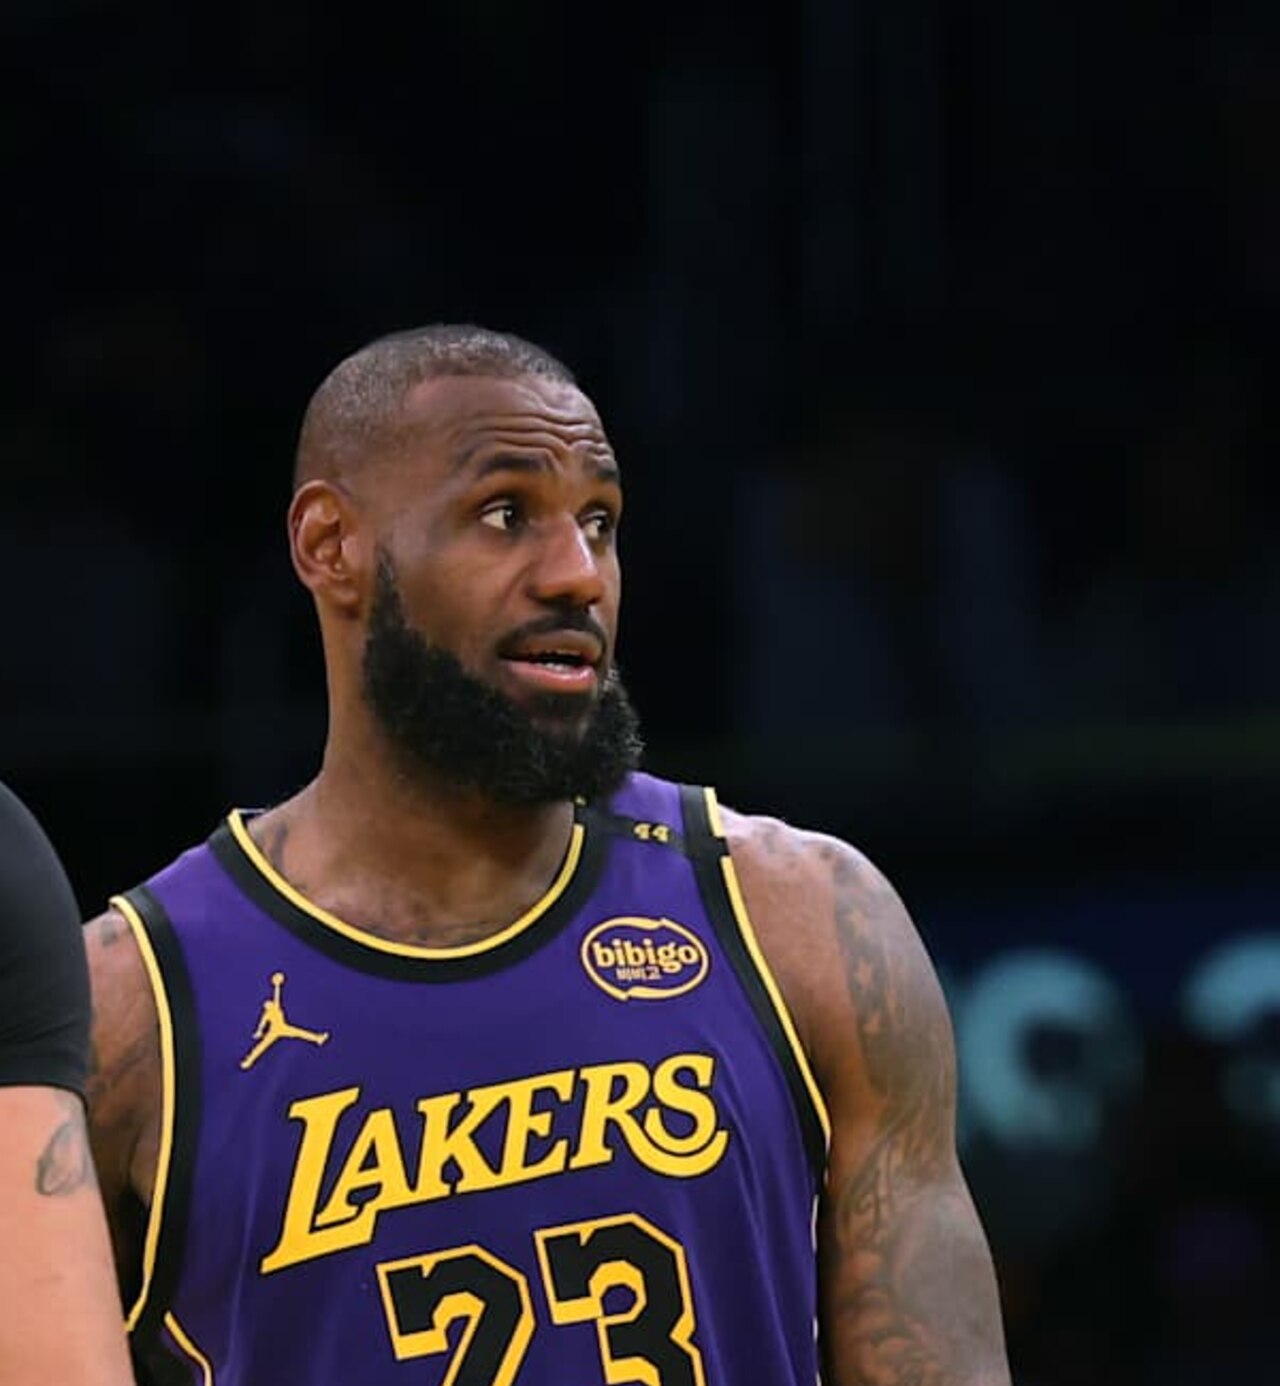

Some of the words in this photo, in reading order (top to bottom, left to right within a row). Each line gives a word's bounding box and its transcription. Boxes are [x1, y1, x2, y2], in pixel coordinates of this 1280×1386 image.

[632, 822, 670, 844] 44
[592, 937, 699, 974] bibigo
[261, 1053, 729, 1274] LAKERS
